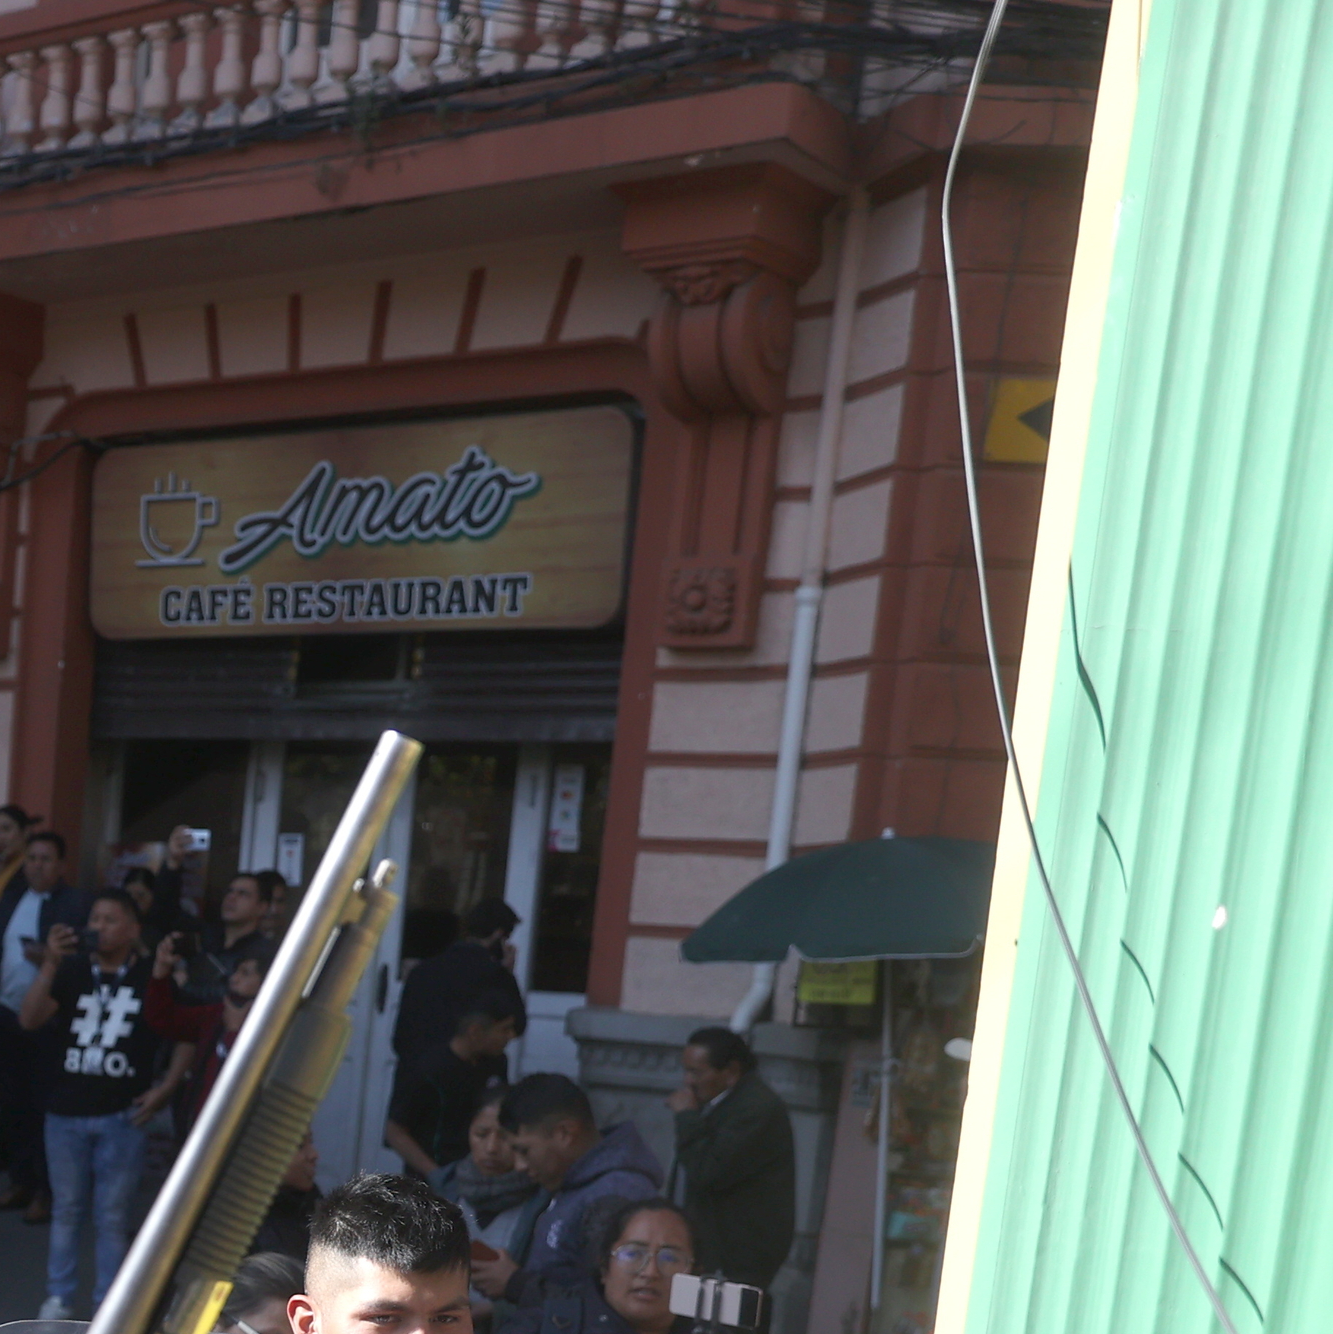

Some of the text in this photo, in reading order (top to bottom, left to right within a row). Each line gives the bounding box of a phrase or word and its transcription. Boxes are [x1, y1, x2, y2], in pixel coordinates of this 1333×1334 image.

[220, 447, 539, 570] Amato
[161, 572, 530, 626] CAFÉ RESTAURANT
